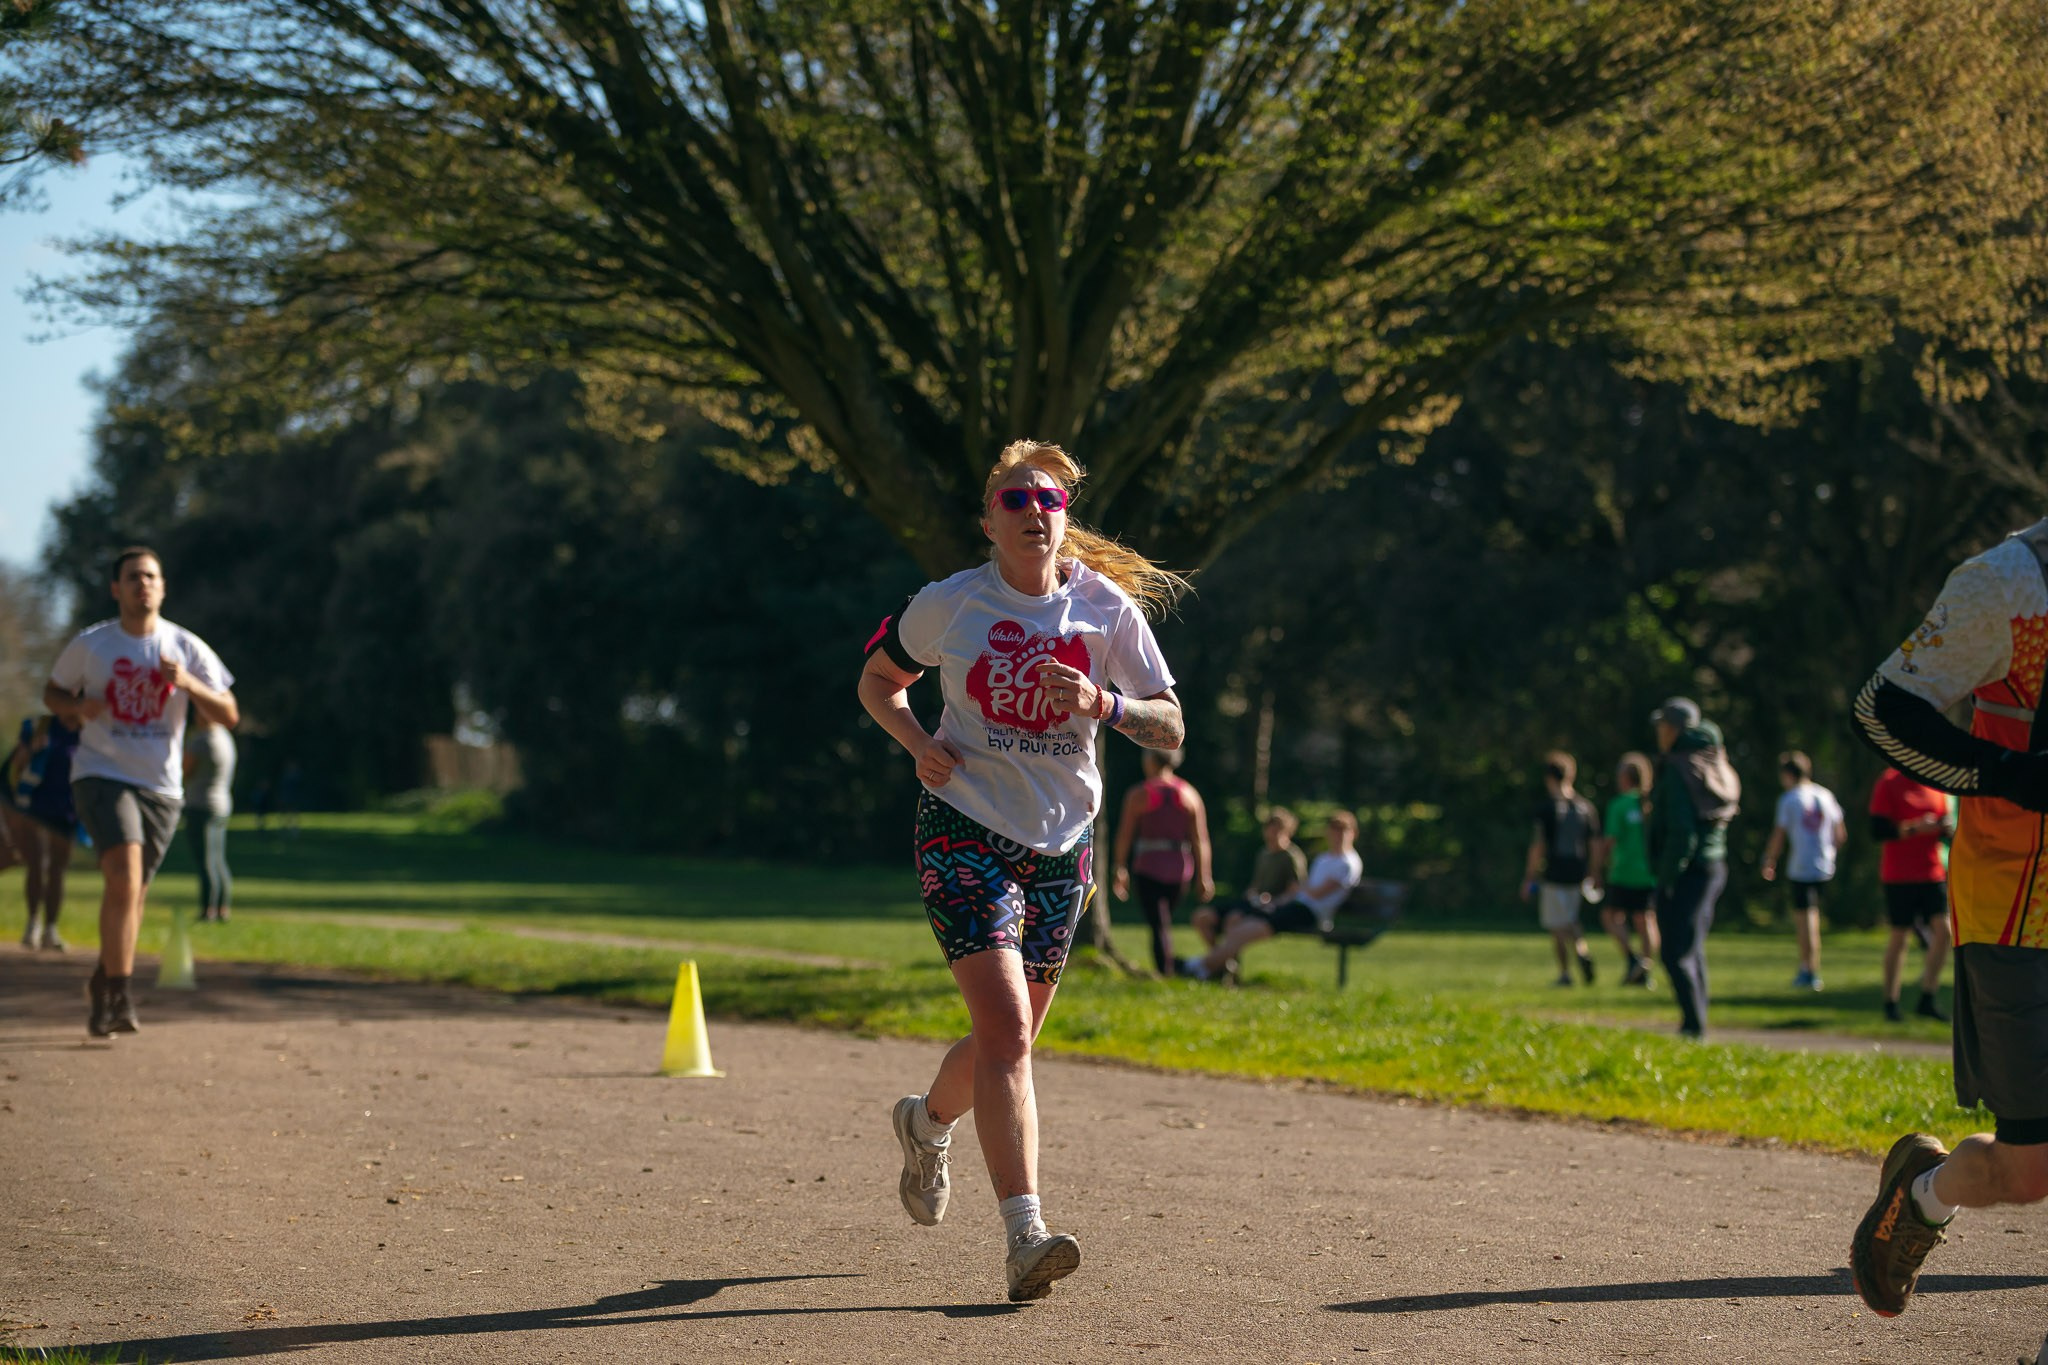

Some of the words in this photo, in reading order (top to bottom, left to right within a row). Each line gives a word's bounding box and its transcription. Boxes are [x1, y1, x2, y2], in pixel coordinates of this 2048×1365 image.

[988, 627, 1026, 647] Vitality
[983, 726, 1021, 737] TALITY
[1874, 1186, 1905, 1242] HOKA
